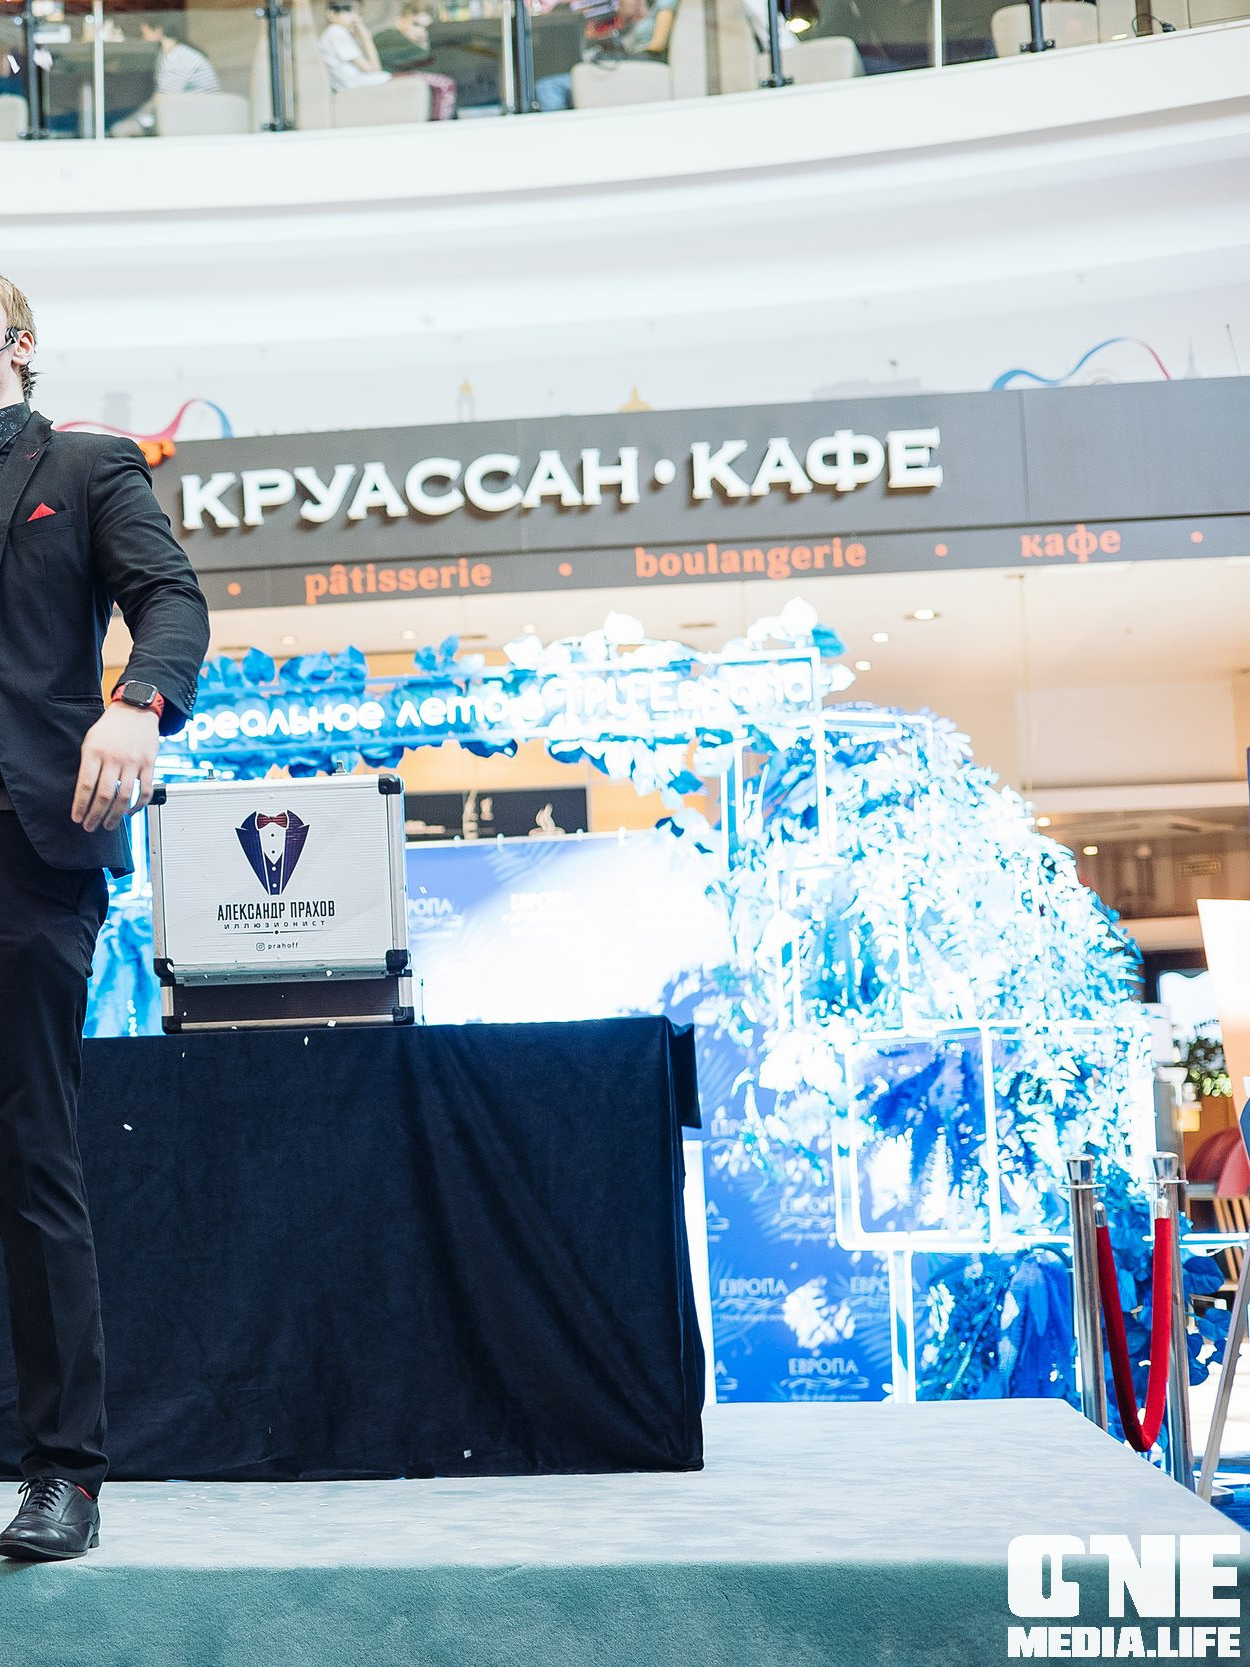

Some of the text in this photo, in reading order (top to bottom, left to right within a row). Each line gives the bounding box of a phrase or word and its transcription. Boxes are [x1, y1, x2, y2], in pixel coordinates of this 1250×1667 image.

[181, 426, 944, 530] КРУАССАН КАФЕ
[635, 537, 867, 579] boulangerie
[1021, 524, 1122, 563] кафе
[304, 557, 492, 605] pâtisserie
[159, 701, 385, 750] реальное
[395, 696, 510, 729] лето
[217, 900, 336, 921] АЛЕКСАНДР ПРАХОВ
[224, 920, 326, 930] ИЛЛЮЗИОНИСТ
[267, 942, 299, 950] prahoff
[719, 1277, 788, 1296] ЕВРОПА
[788, 1357, 858, 1377] ЕВРОПА
